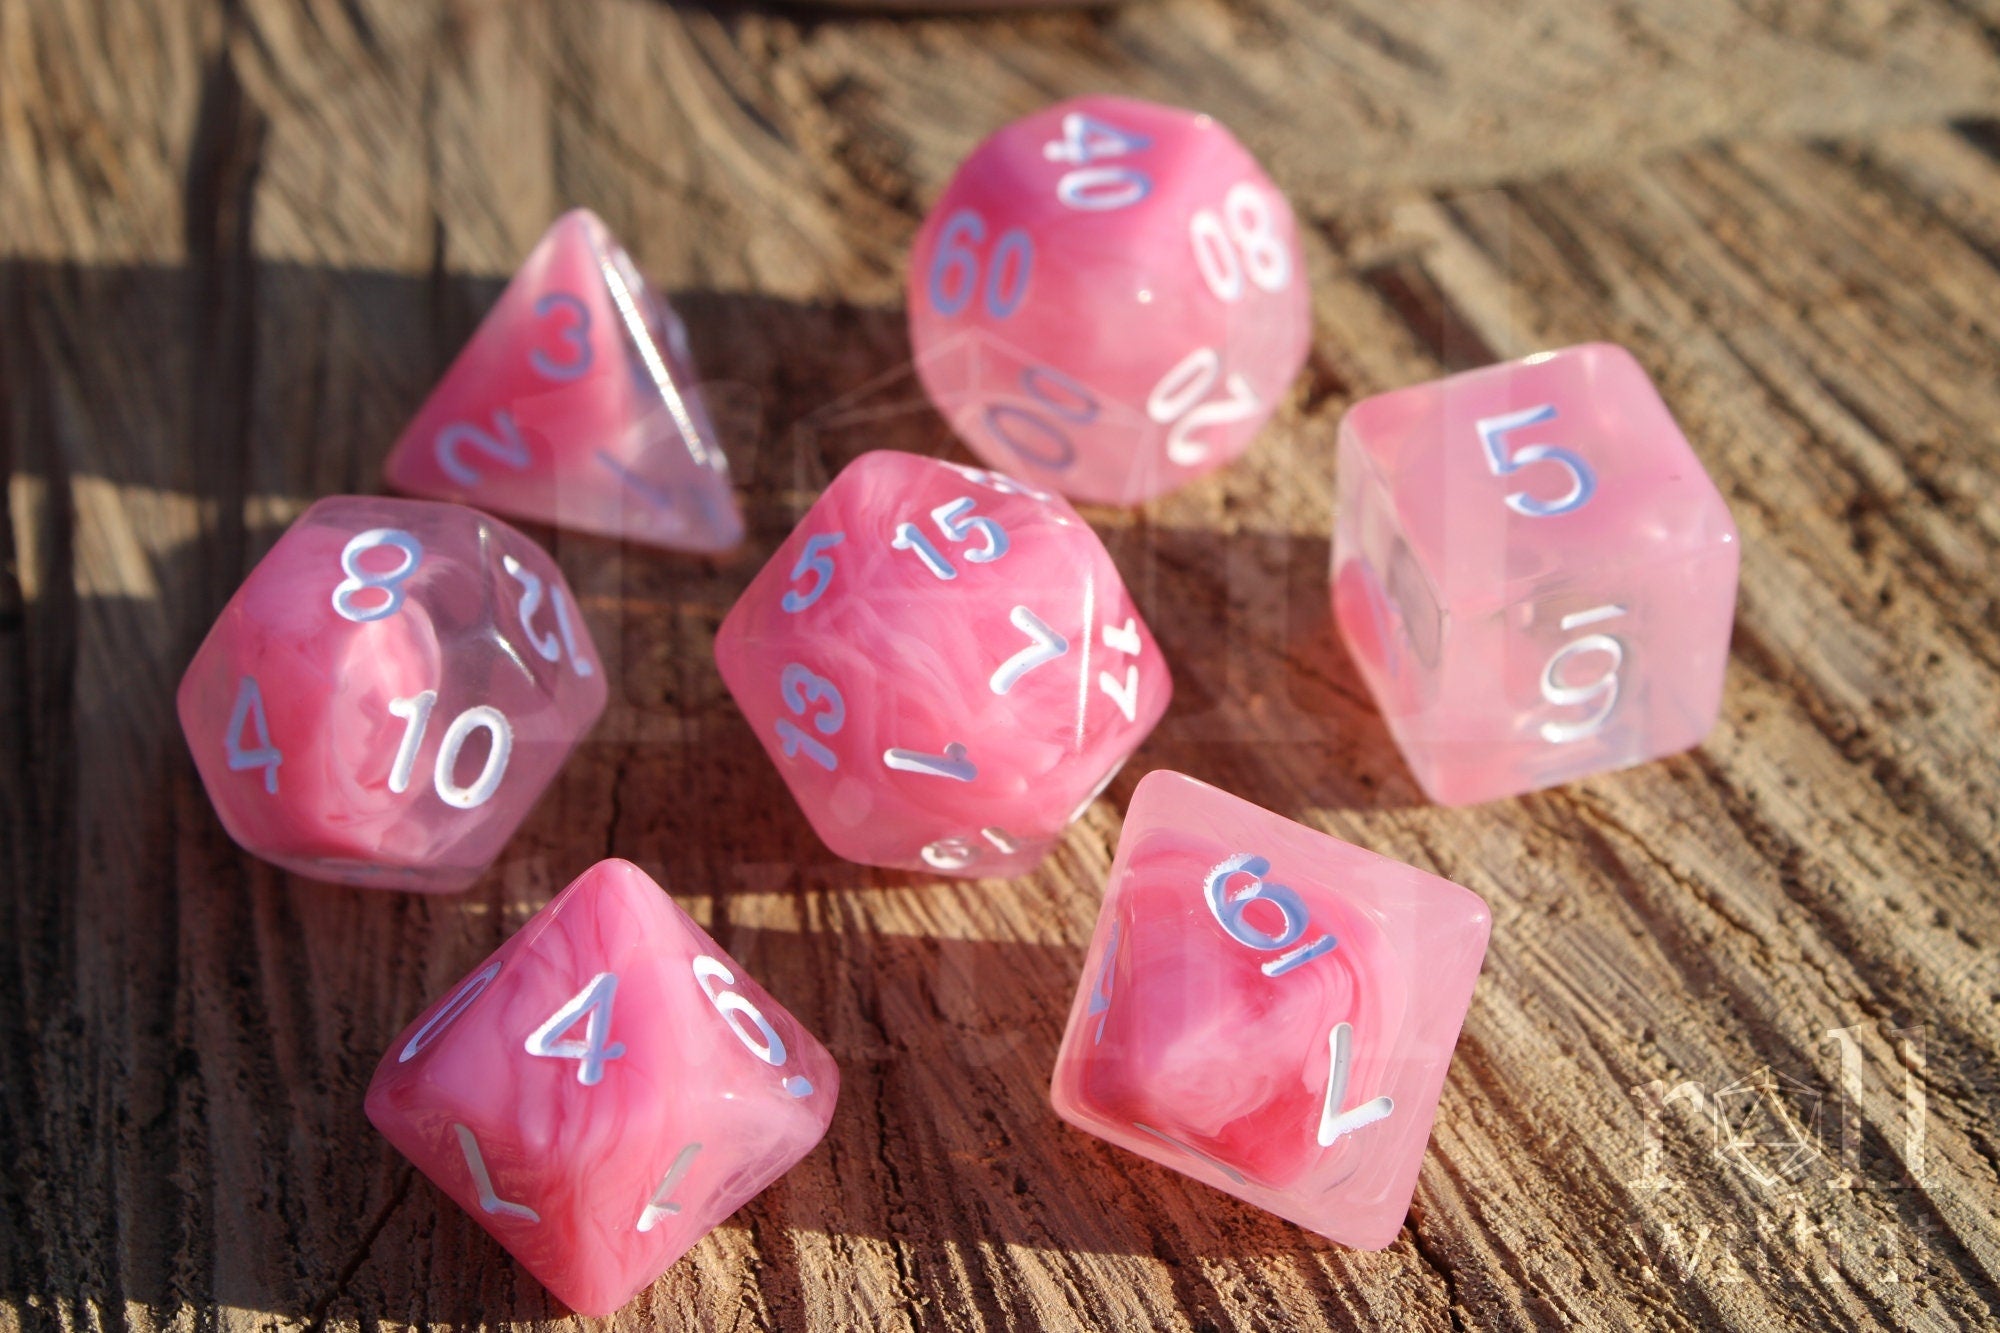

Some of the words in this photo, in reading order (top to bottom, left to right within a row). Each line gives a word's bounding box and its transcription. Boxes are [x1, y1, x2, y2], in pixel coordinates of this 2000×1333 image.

[1042, 111, 1153, 212] 40
[928, 207, 1034, 320] 60
[1188, 181, 1290, 303] 80
[528, 292, 594, 382] 3
[433, 406, 532, 488] 2
[984, 364, 1099, 473] 00
[1146, 346, 1262, 467] 20
[1475, 404, 1597, 518] 5
[331, 527, 424, 623] 8
[781, 530, 846, 614] 5
[890, 496, 1010, 581] 15
[989, 604, 1069, 696] 7
[225, 675, 284, 795] 4
[387, 689, 514, 810] 10
[774, 662, 847, 772] 13
[883, 741, 979, 782] 1
[398, 961, 502, 1063] 0
[524, 972, 626, 1086] 4
[1317, 1022, 1395, 1147] 7
